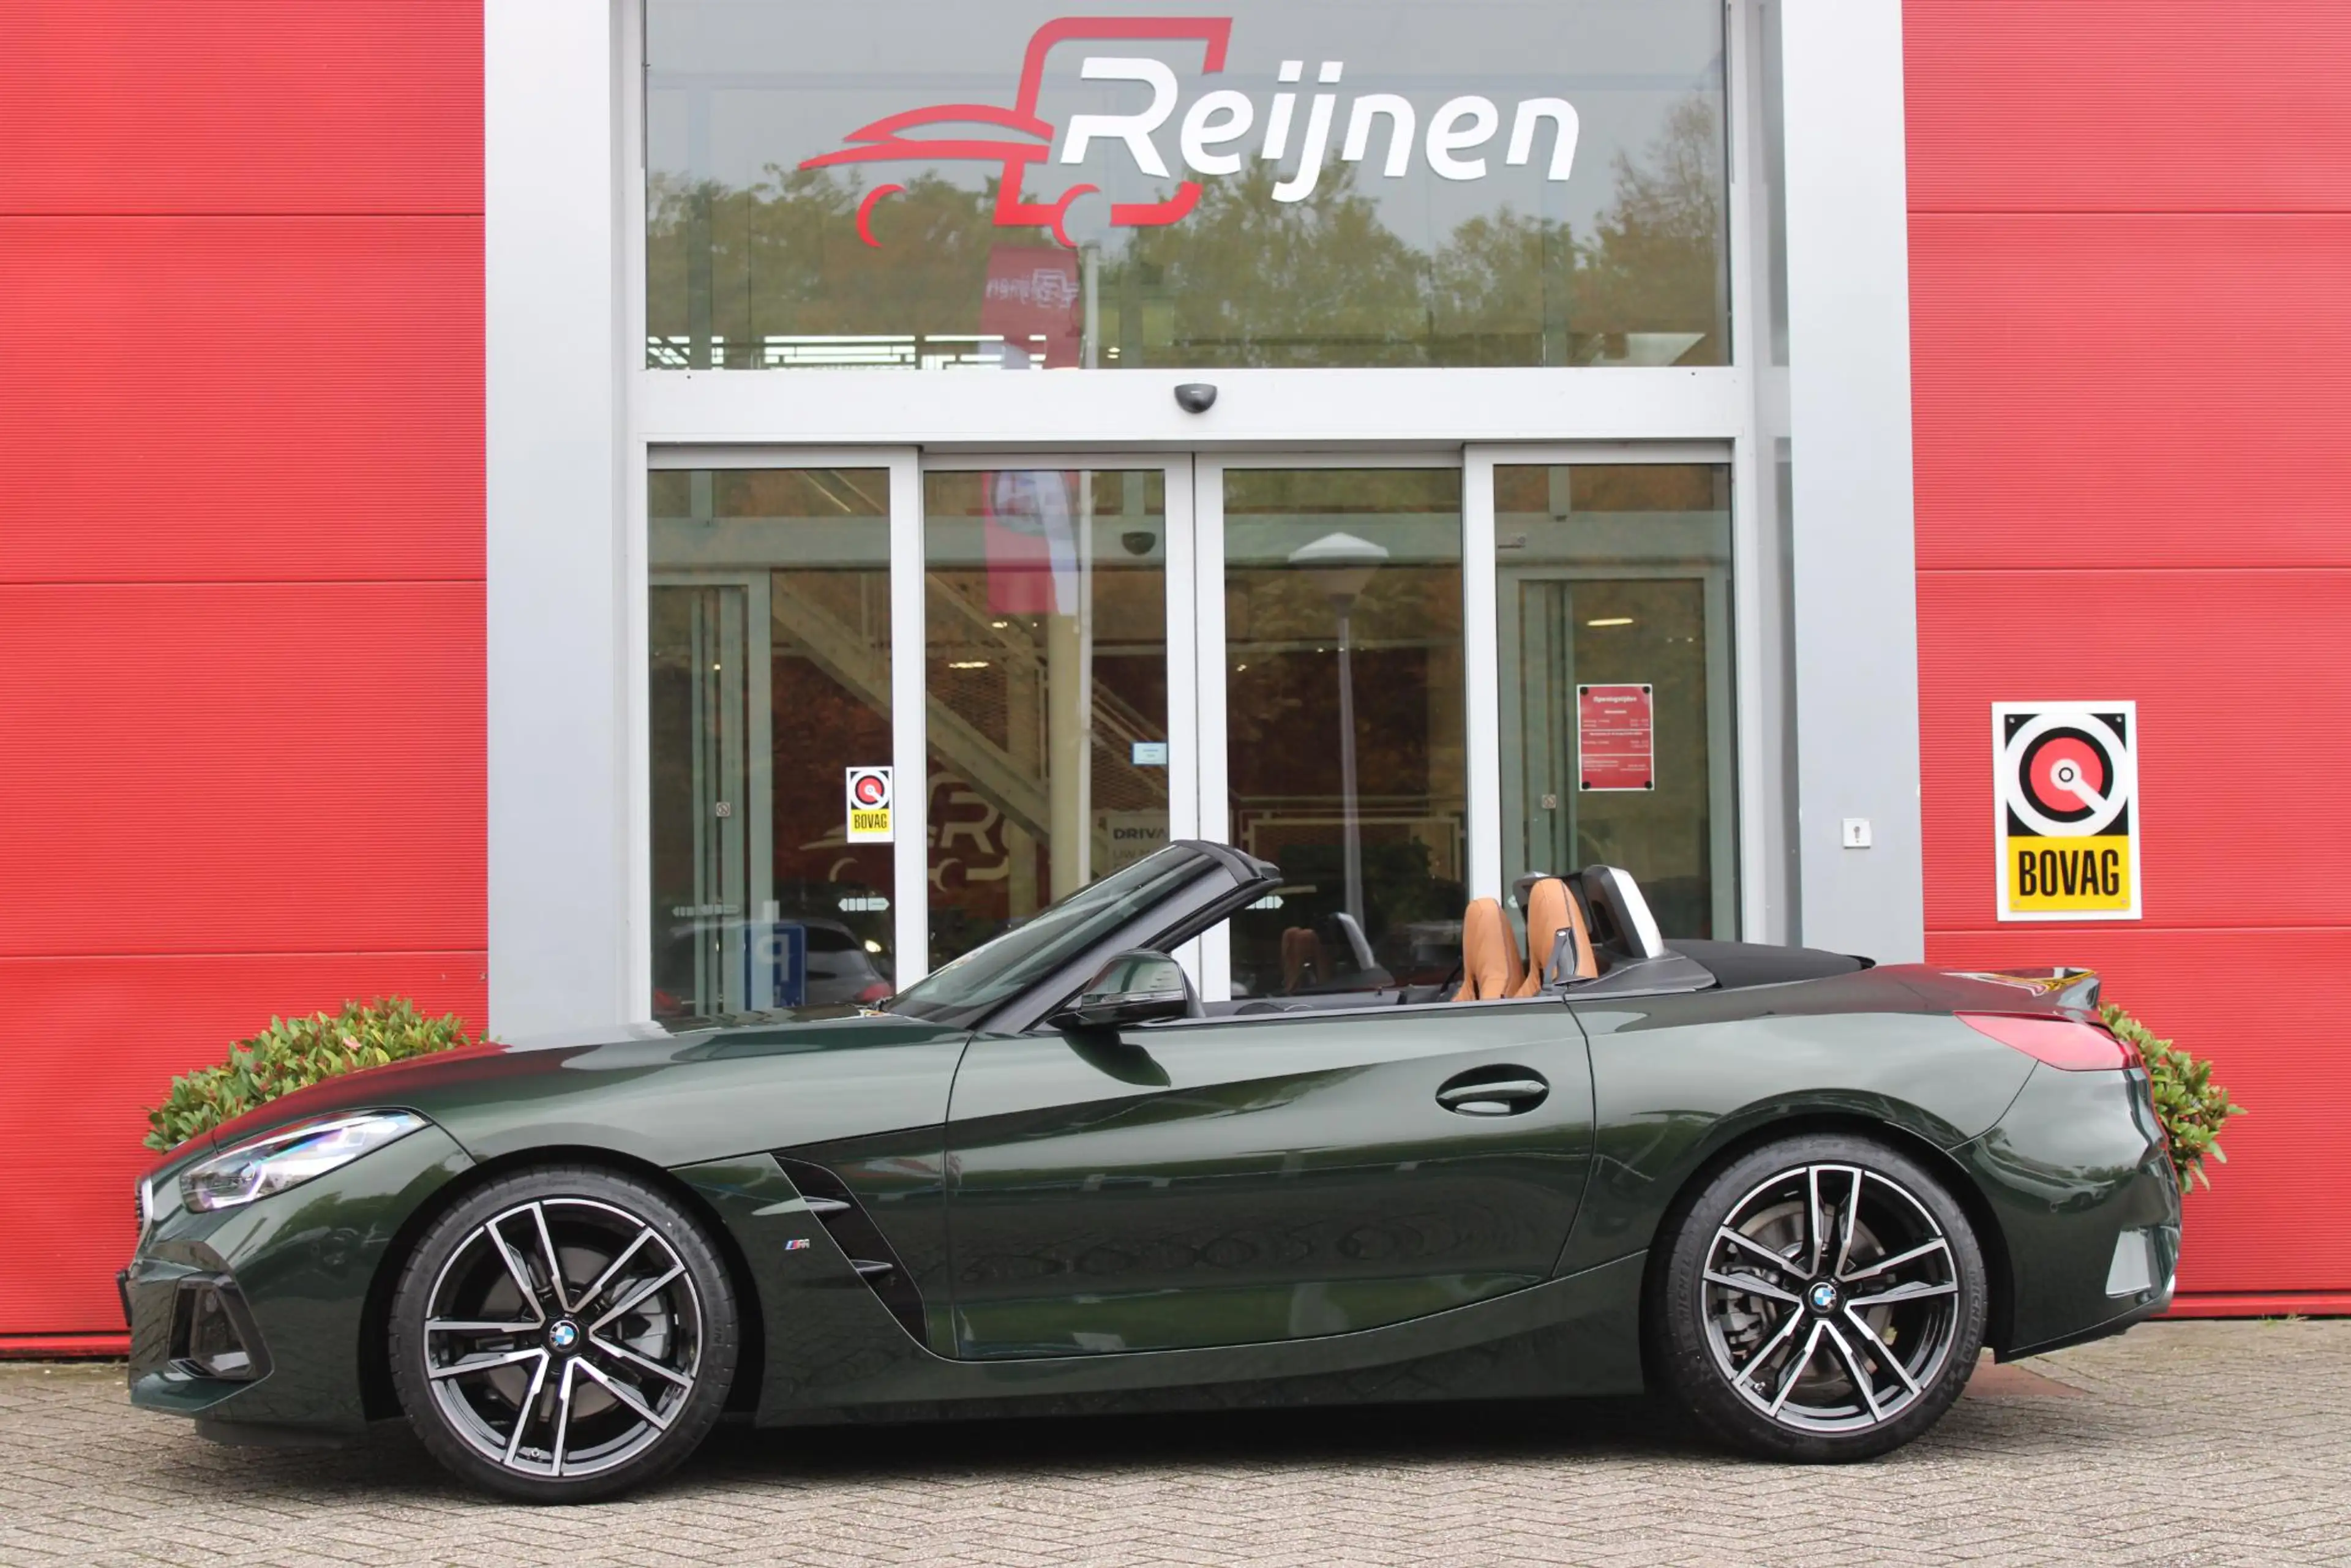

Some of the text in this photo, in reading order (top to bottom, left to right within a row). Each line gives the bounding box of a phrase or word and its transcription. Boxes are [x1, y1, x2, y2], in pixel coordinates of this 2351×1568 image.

[1060, 58, 1580, 202] Reijnen
[854, 813, 887, 829] BOVAG
[2019, 849, 2120, 897] BOVAG
